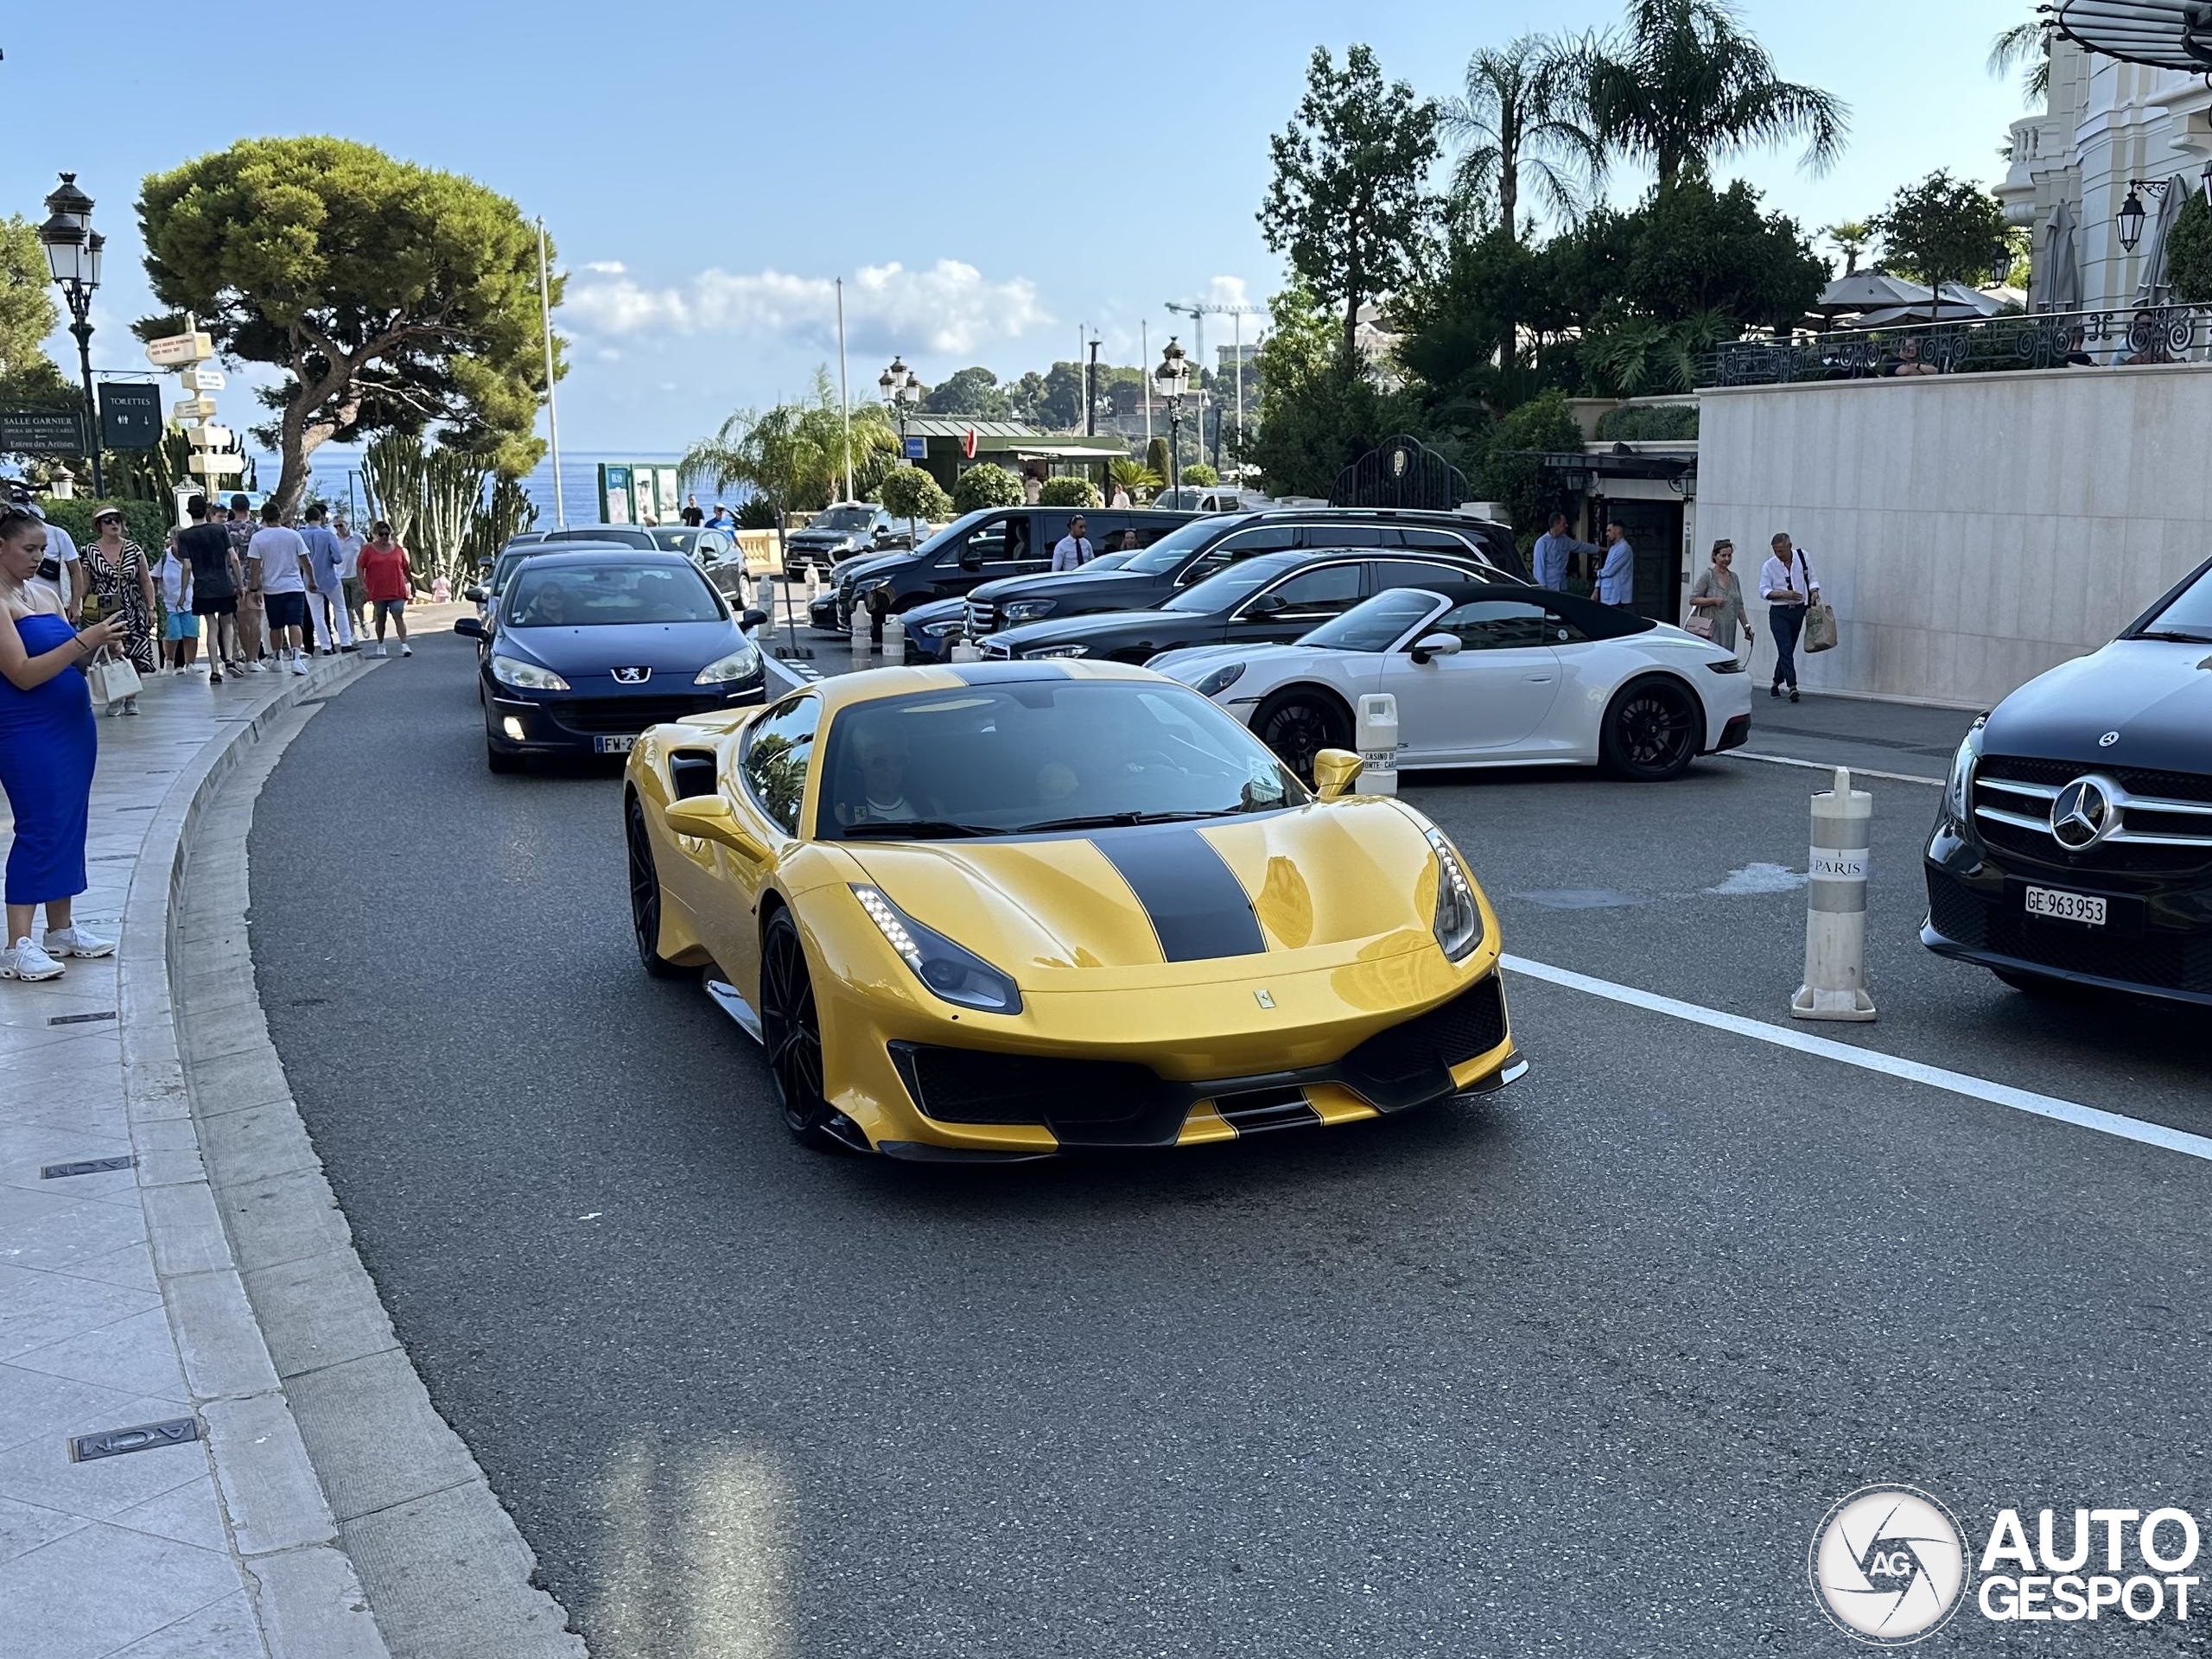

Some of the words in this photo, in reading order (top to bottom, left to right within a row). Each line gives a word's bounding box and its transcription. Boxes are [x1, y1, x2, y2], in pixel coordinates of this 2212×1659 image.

[110, 397, 151, 406] TOILETTES
[604, 737, 639, 752] FW-2
[1389, 752, 1395, 760] DE
[1815, 860, 1861, 876] PARIS
[2027, 891, 2044, 912] GE
